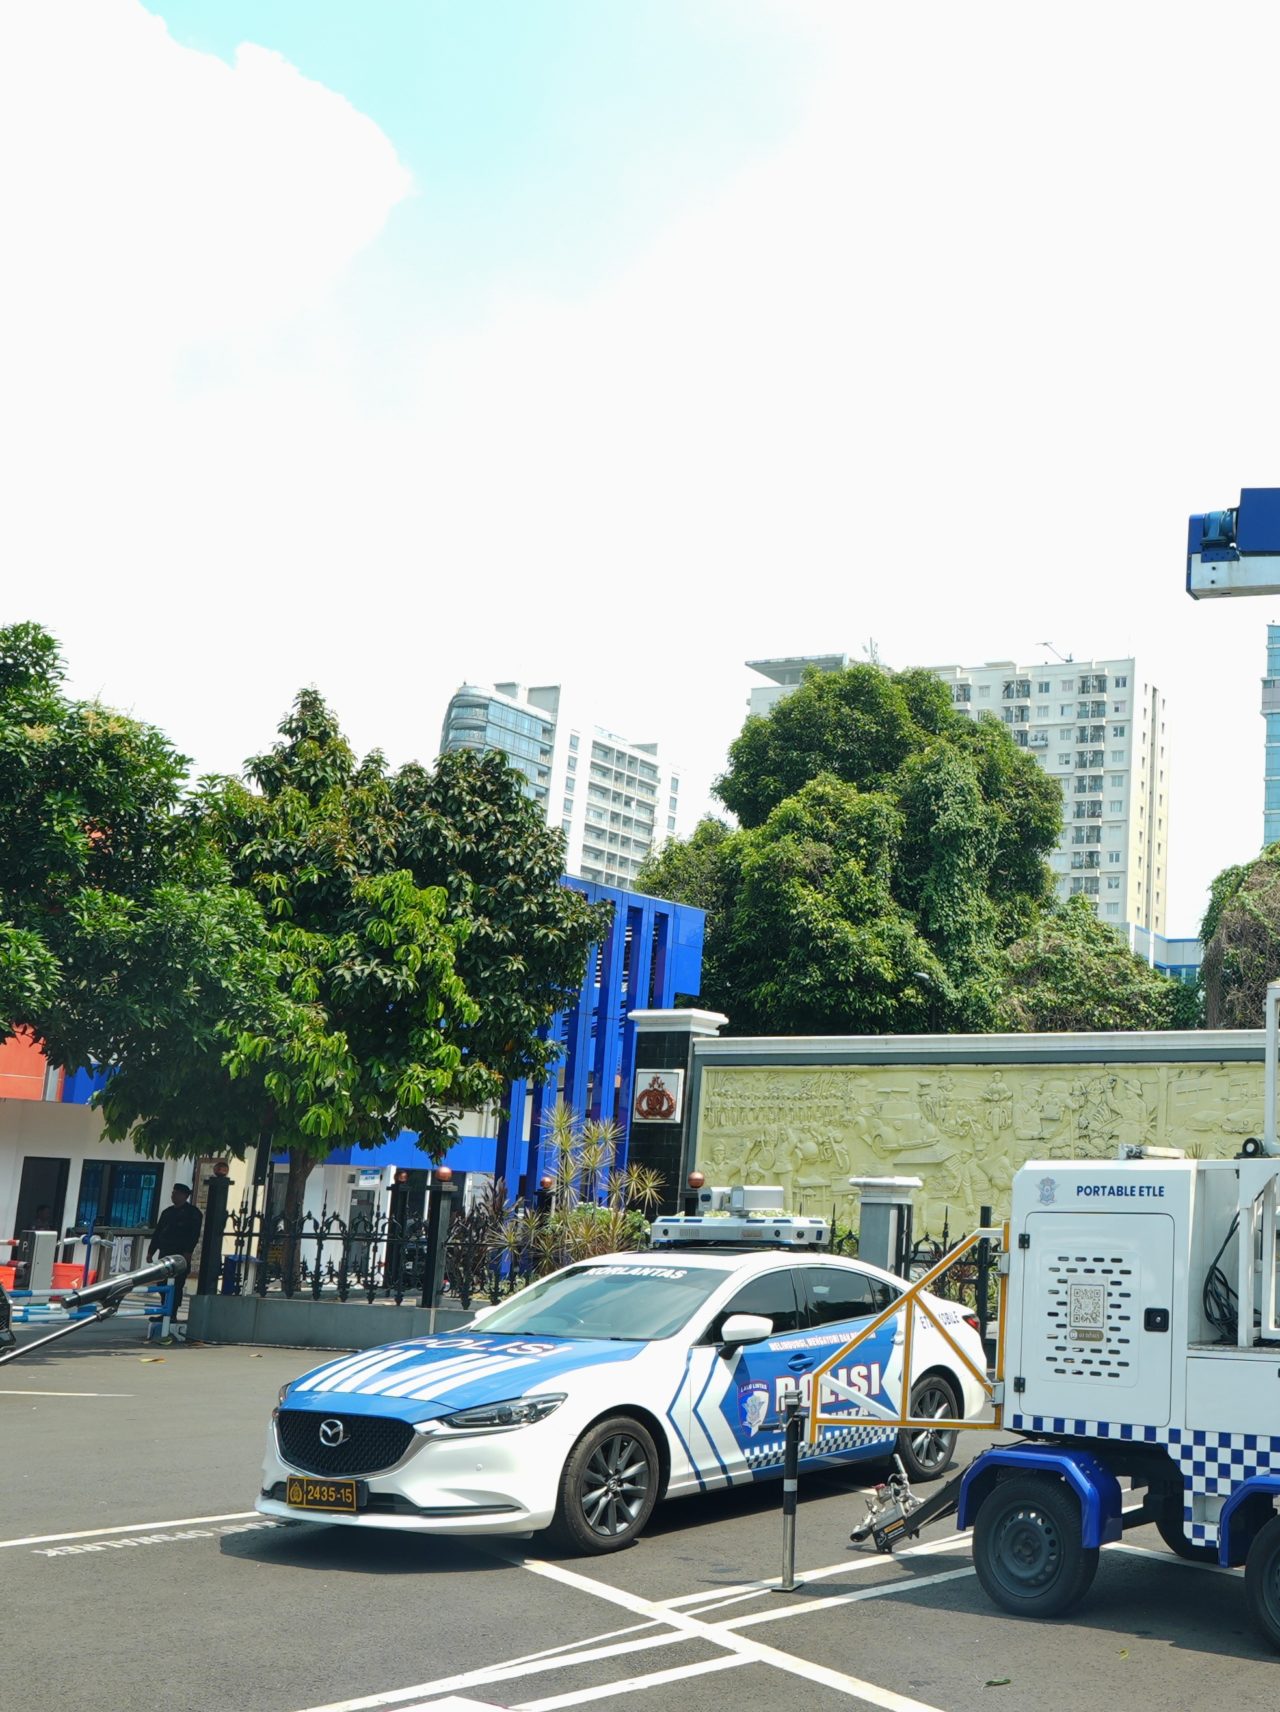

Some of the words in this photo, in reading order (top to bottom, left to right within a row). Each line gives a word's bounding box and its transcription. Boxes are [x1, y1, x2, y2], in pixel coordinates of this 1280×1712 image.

[1076, 1185, 1136, 1197] PORTABLE
[1138, 1186, 1165, 1197] ETLE
[582, 1265, 687, 1279] KORLANTAS
[390, 1339, 573, 1357] POLISI
[775, 1362, 880, 1412] POLISI
[307, 1485, 353, 1503] 2435-15
